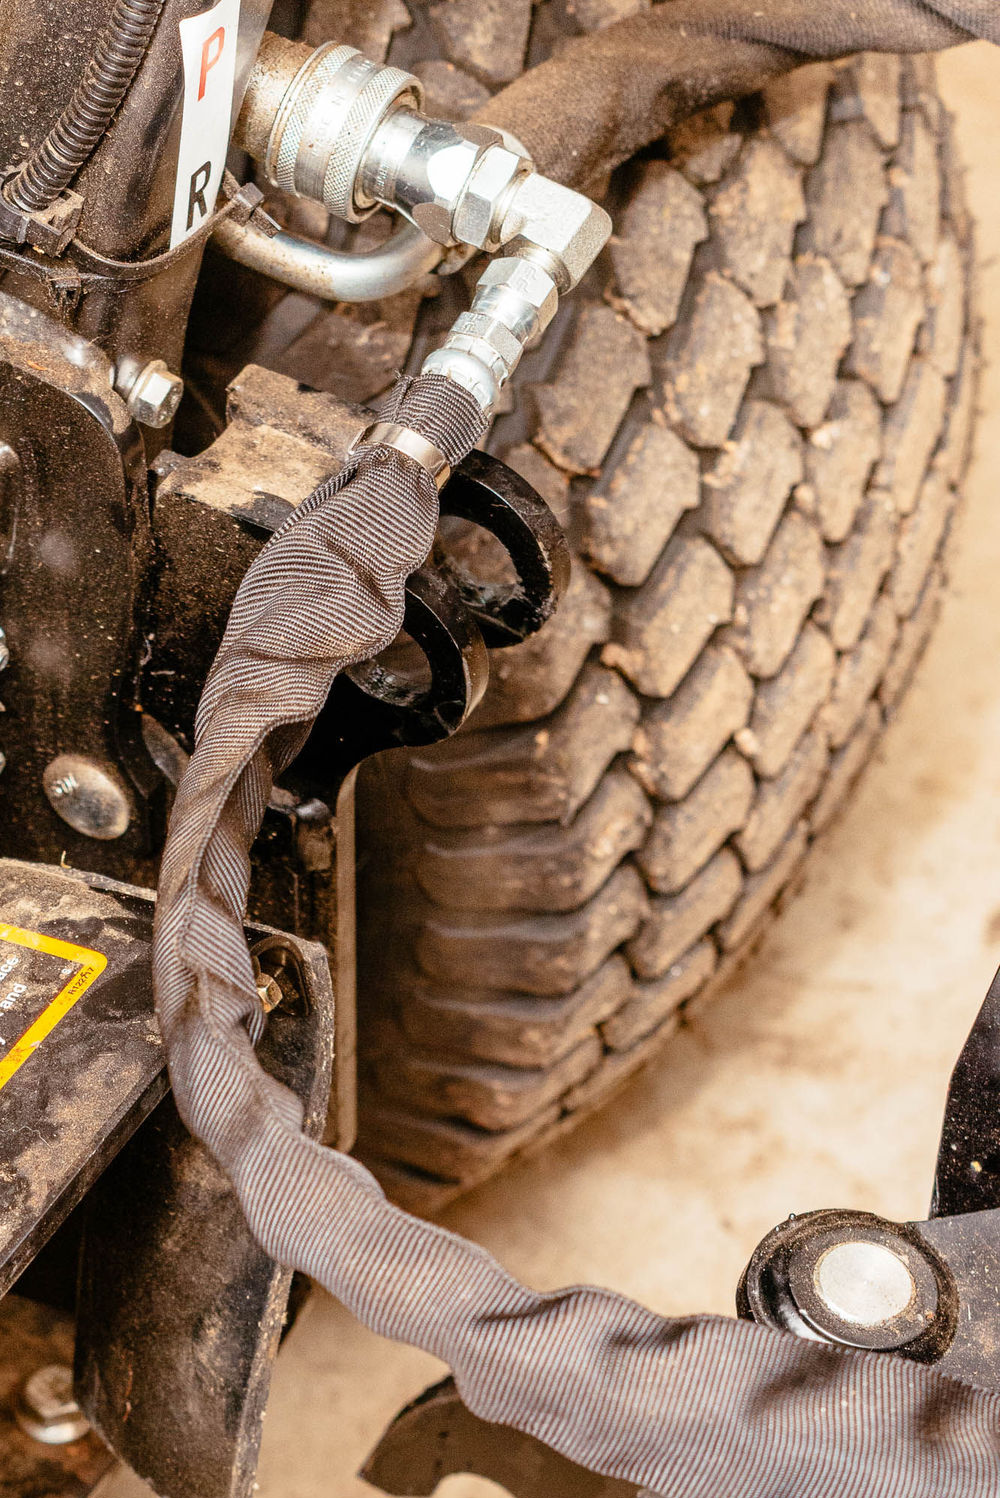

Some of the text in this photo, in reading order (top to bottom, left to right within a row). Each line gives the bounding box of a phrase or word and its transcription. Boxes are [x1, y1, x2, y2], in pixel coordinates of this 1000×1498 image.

[197, 26, 225, 102] P
[186, 160, 212, 231] R
[0, 982, 28, 1009] and
